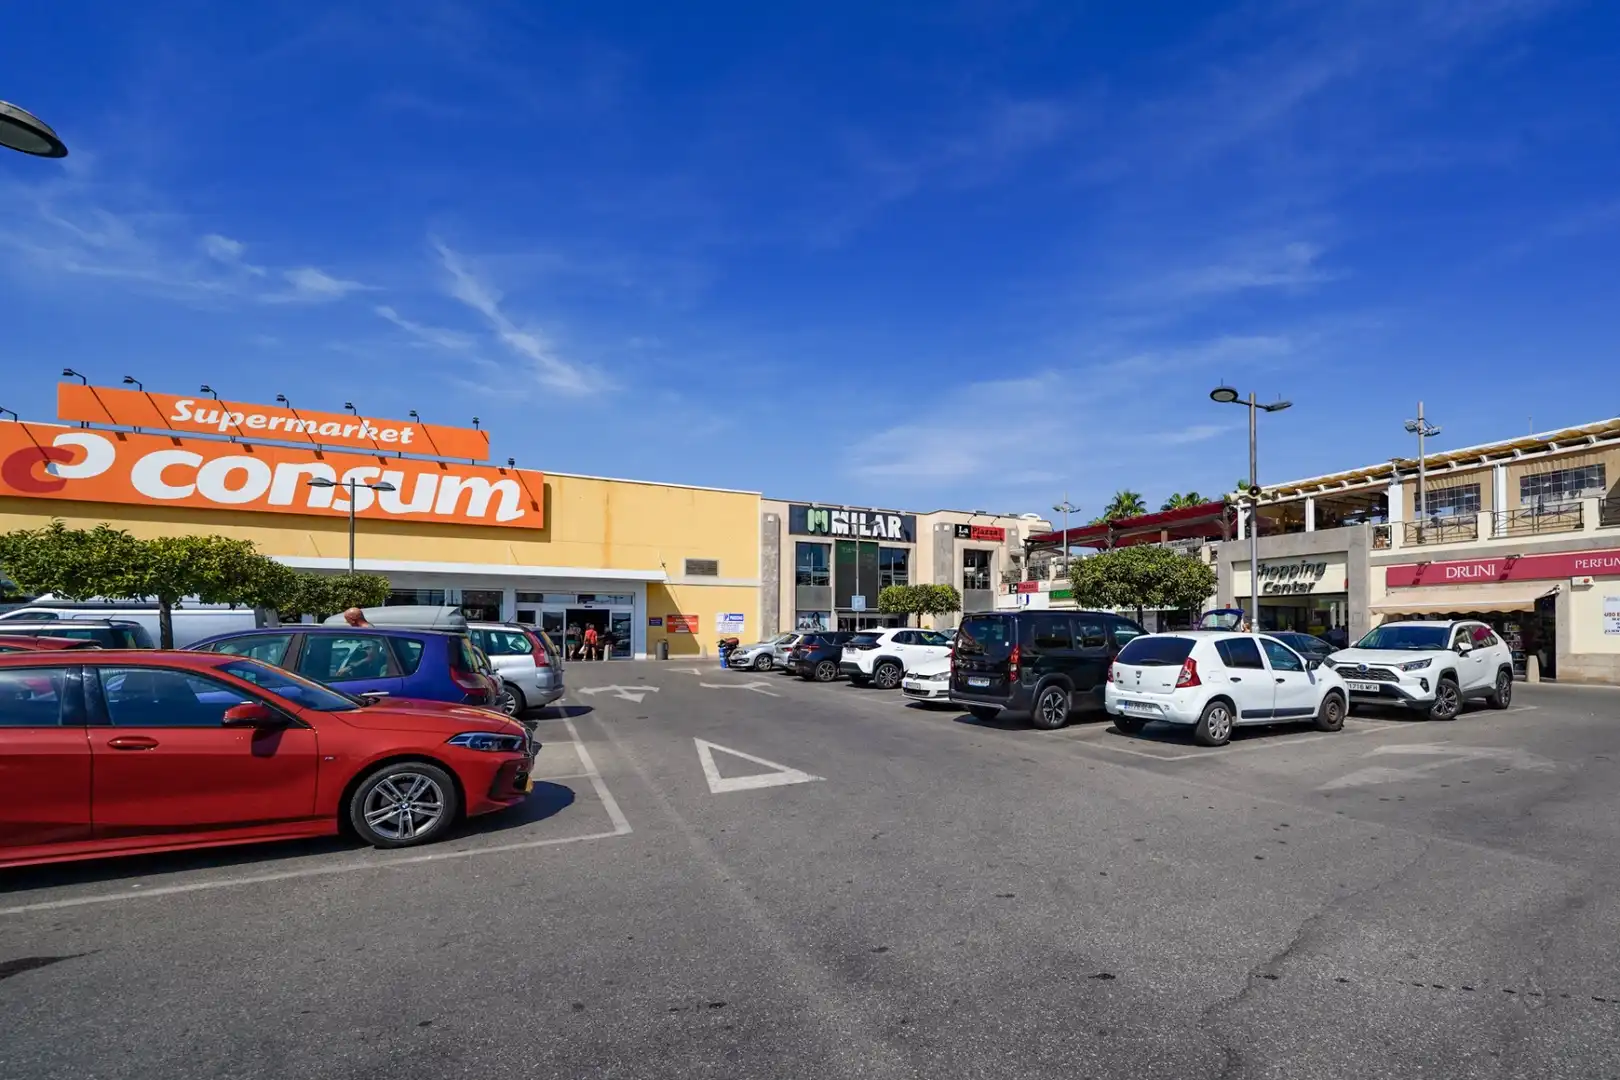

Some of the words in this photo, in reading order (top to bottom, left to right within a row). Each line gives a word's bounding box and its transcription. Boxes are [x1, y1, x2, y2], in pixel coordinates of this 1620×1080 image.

[171, 399, 415, 445] Supermarket
[130, 449, 525, 522] consum
[831, 510, 902, 539] MILAR
[1446, 564, 1495, 578] DRUNI
[1263, 581, 1316, 594] Center
